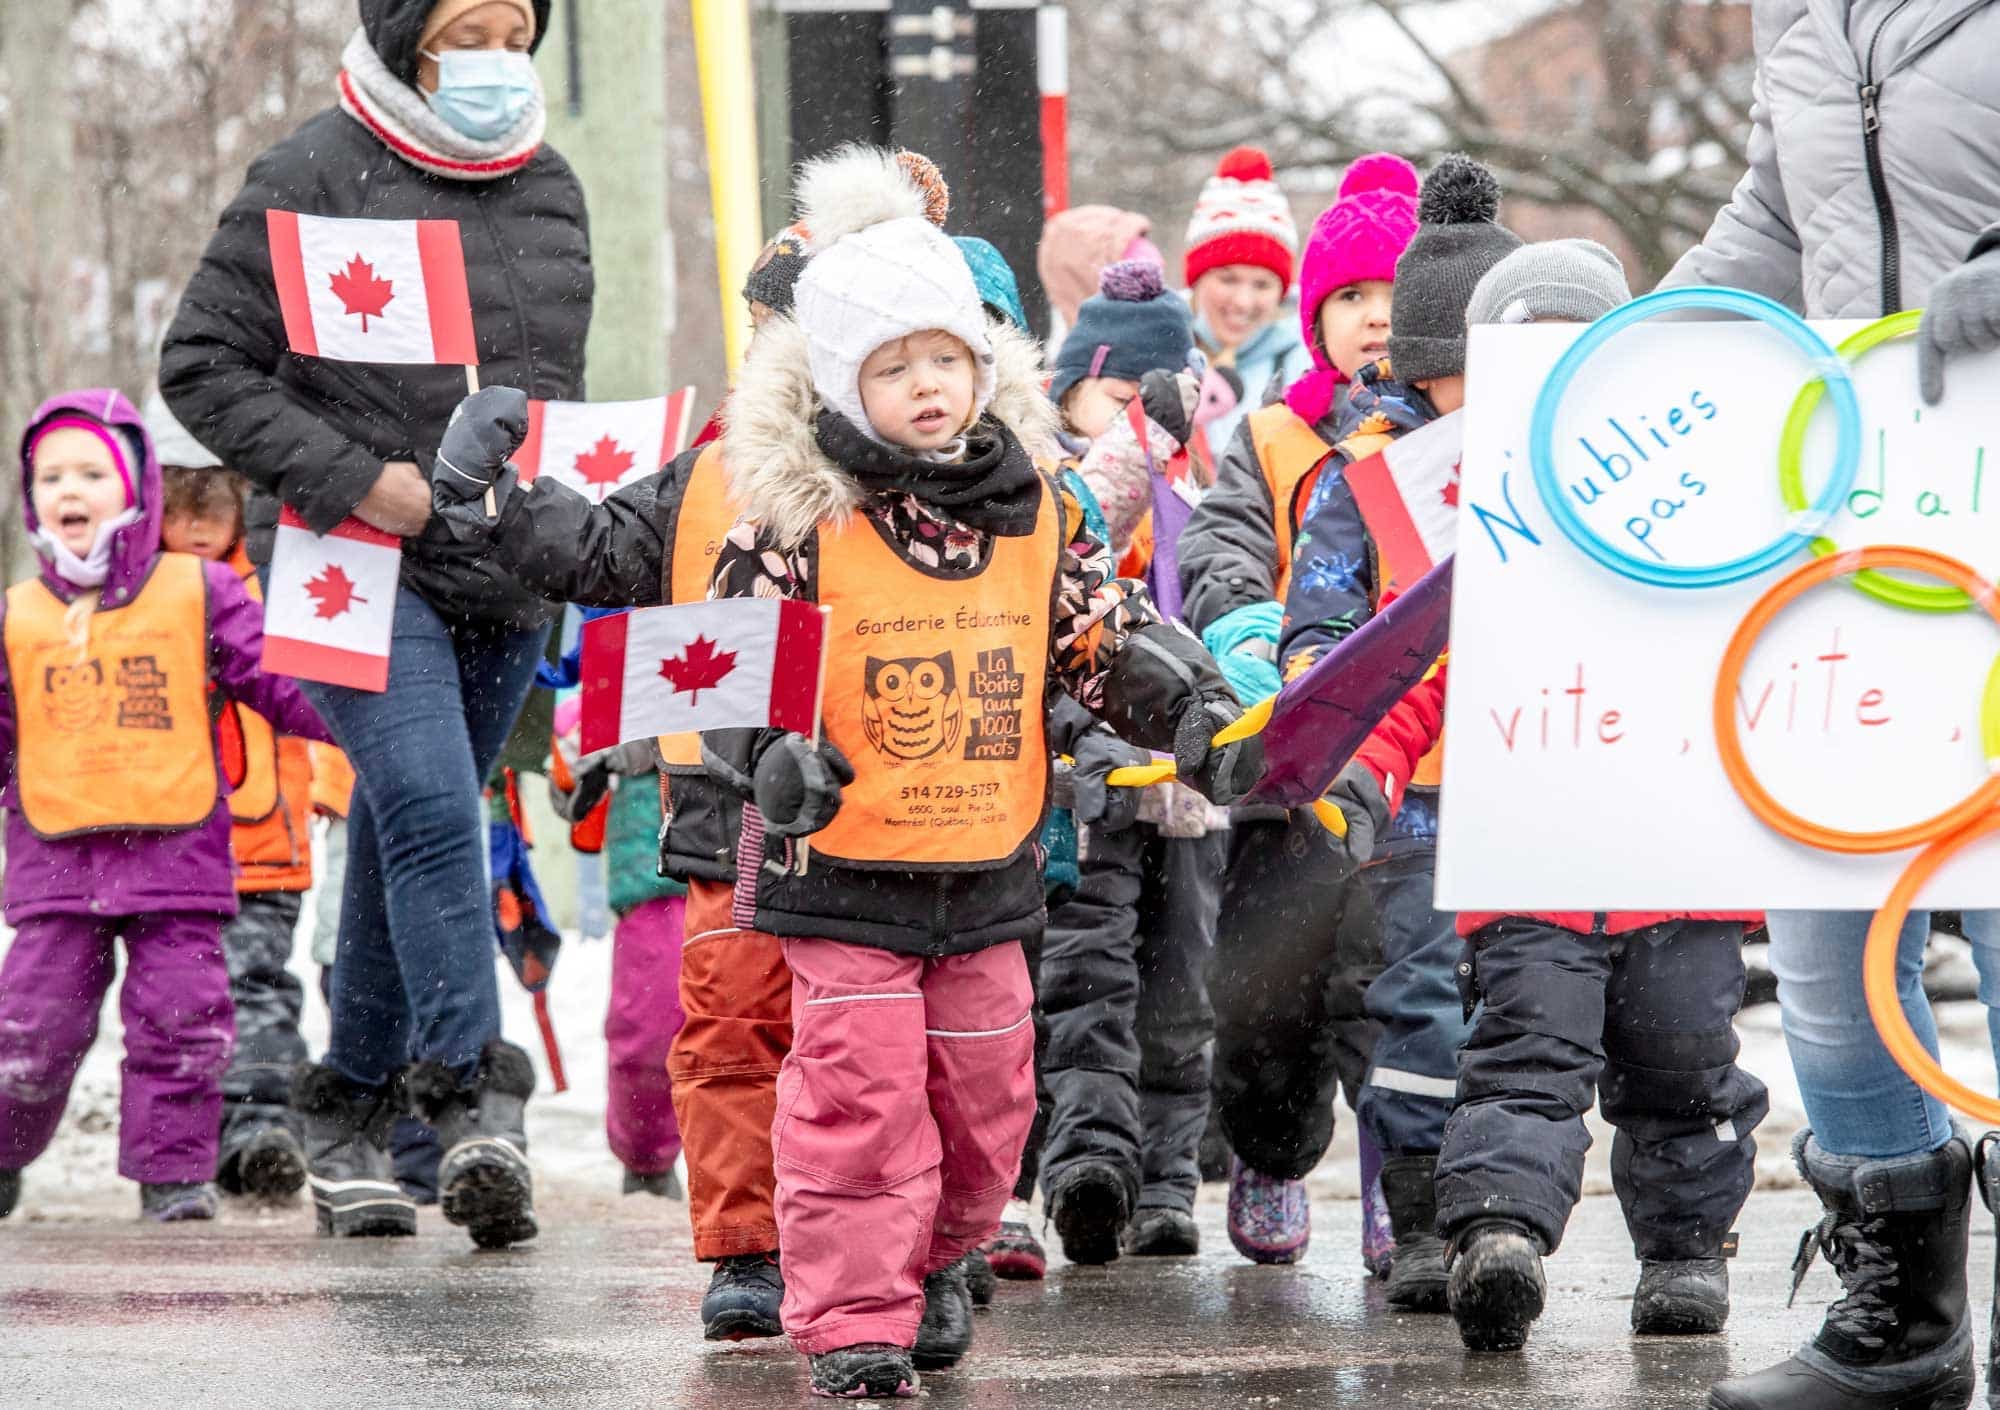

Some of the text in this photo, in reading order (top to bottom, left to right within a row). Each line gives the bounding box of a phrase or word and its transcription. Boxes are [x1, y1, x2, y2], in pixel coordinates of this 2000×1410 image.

[1625, 472, 1707, 561] pas
[856, 605, 1031, 636] Garderie Éducative
[987, 650, 1008, 673] La
[1737, 626, 1892, 732] vite
[983, 699, 1013, 712] aux
[1490, 662, 1625, 752] vite
[980, 715, 1015, 736] 1000
[975, 737, 1016, 756] mots
[901, 783, 1000, 799] 514 729-5757
